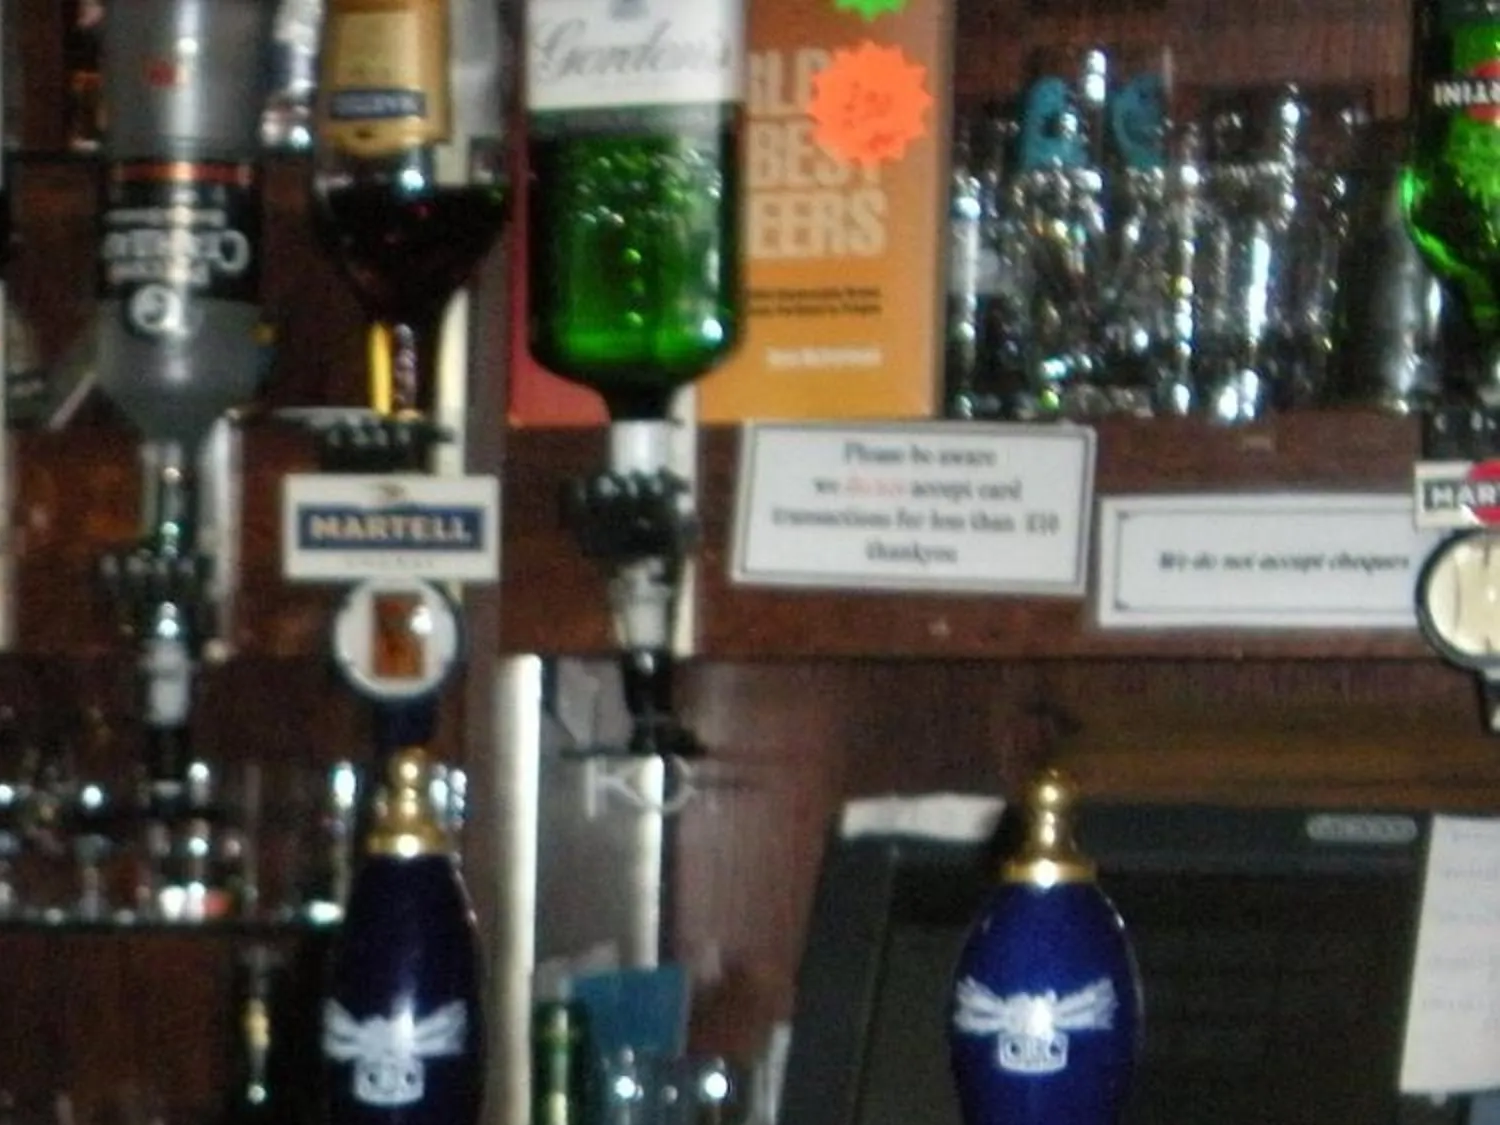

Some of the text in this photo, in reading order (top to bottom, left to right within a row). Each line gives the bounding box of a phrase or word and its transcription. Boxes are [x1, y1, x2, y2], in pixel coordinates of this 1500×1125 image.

[978, 479, 1022, 499] card
[310, 513, 472, 545] MARTELL
[970, 511, 1016, 533] than
